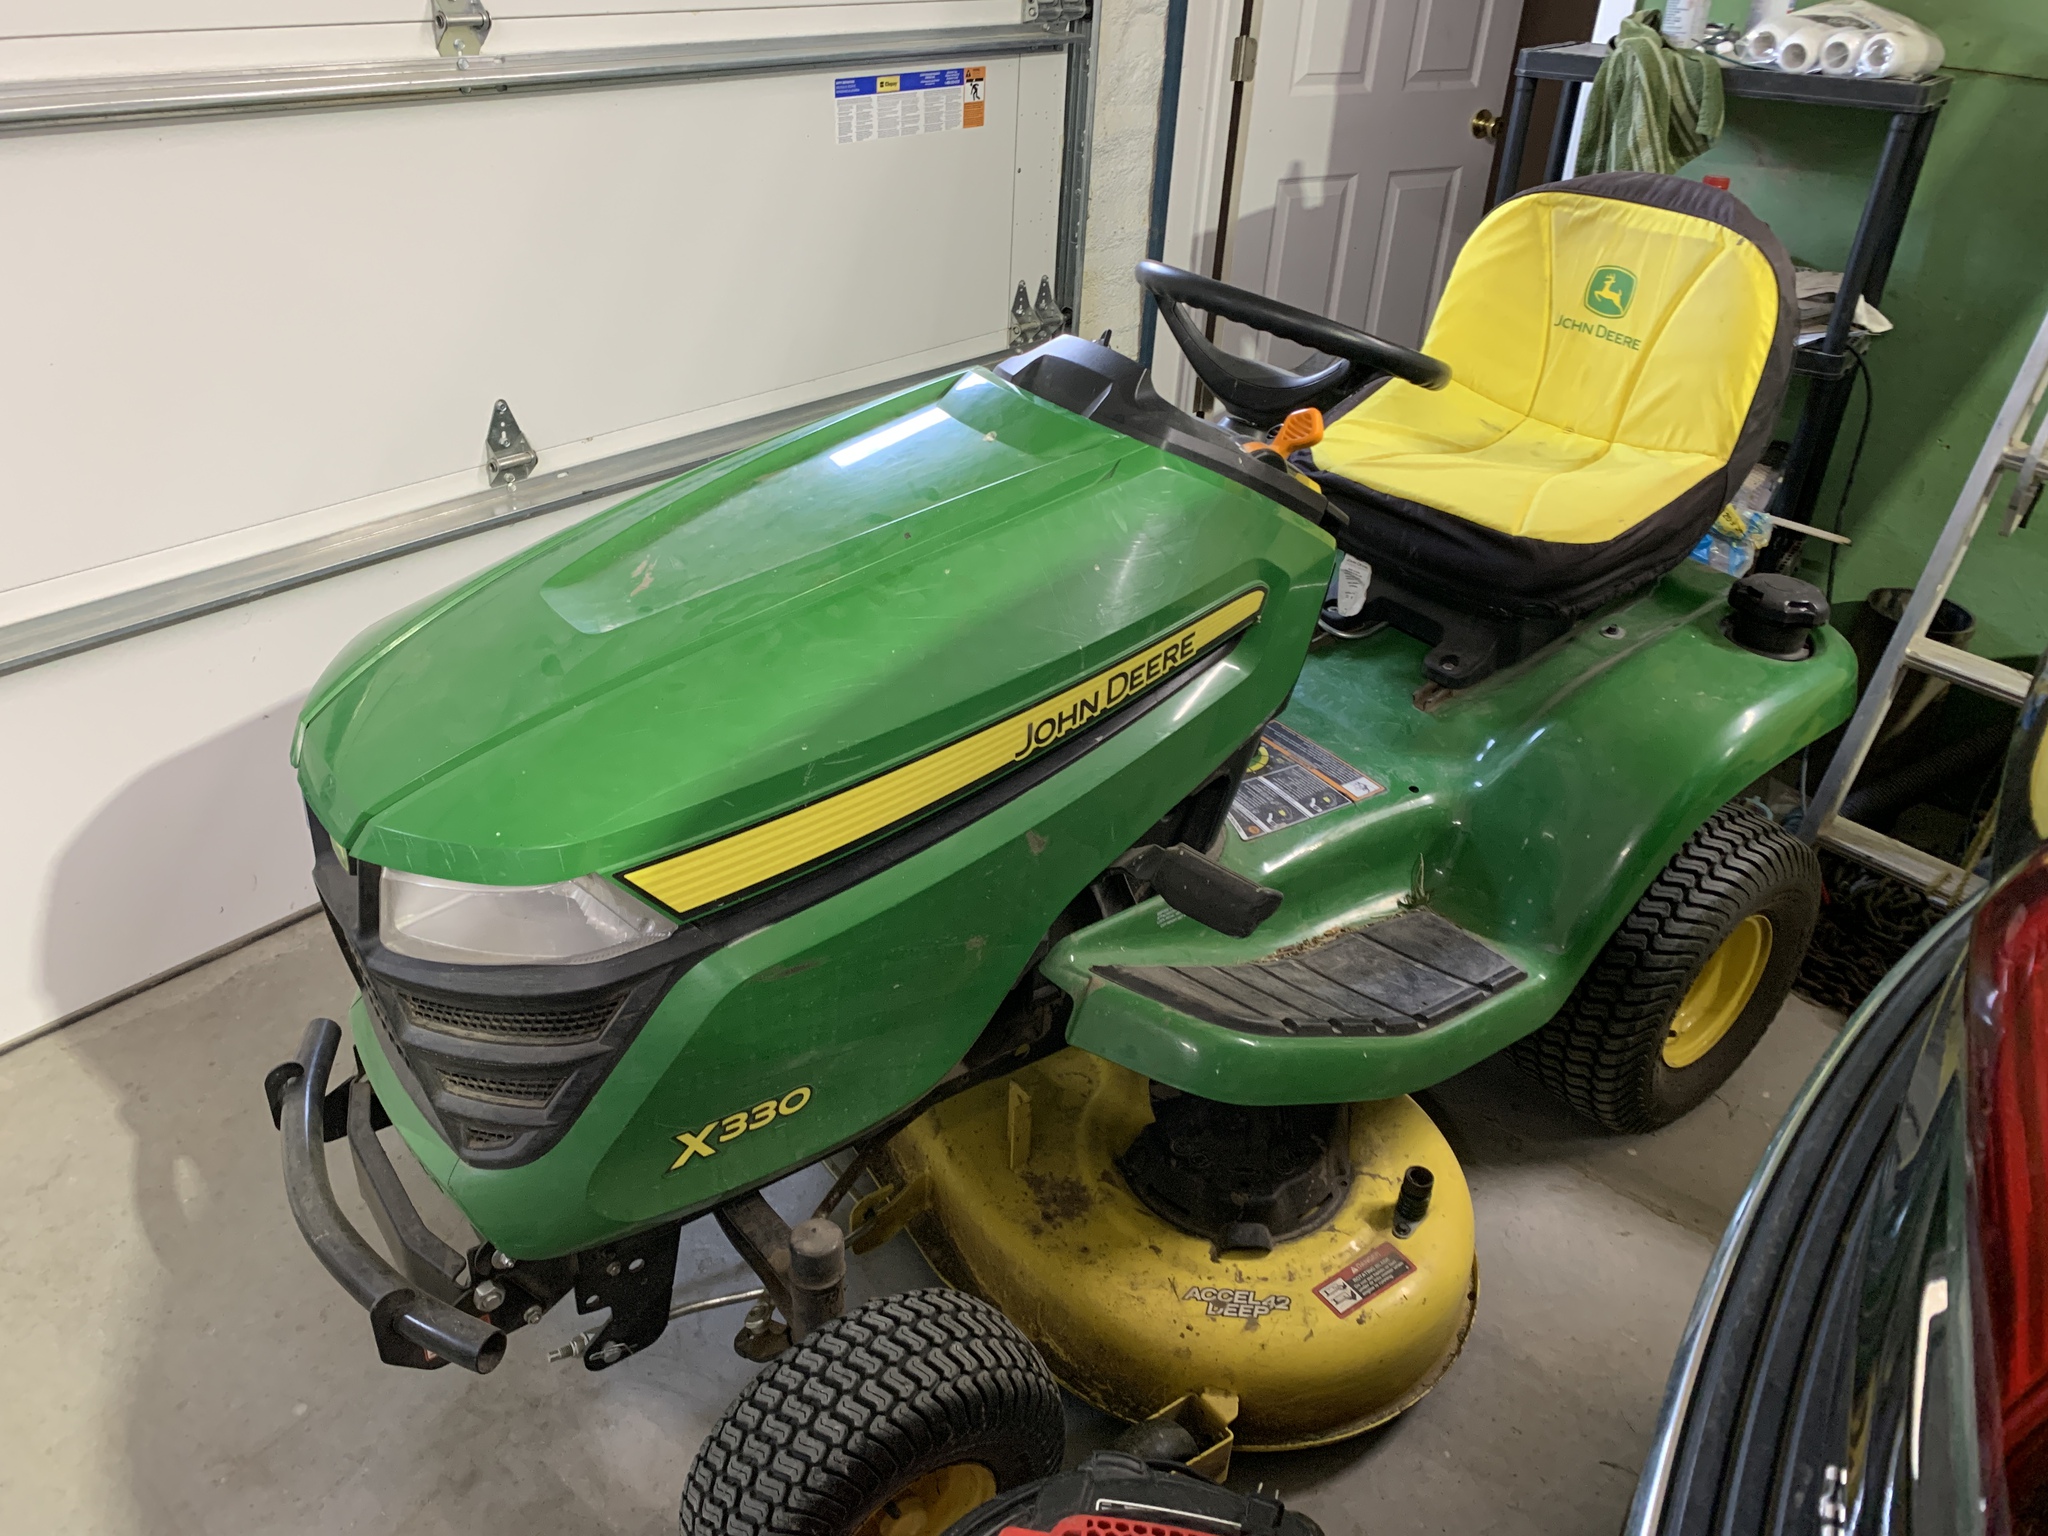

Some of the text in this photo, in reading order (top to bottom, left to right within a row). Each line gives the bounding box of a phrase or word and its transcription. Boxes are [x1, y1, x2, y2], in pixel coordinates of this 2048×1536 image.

[1595, 324, 1642, 351] DEERE
[1014, 630, 1197, 760] JOHN DEERE
[667, 1084, 814, 1173] X330
[1182, 1285, 1292, 1311] ACCEL 42
